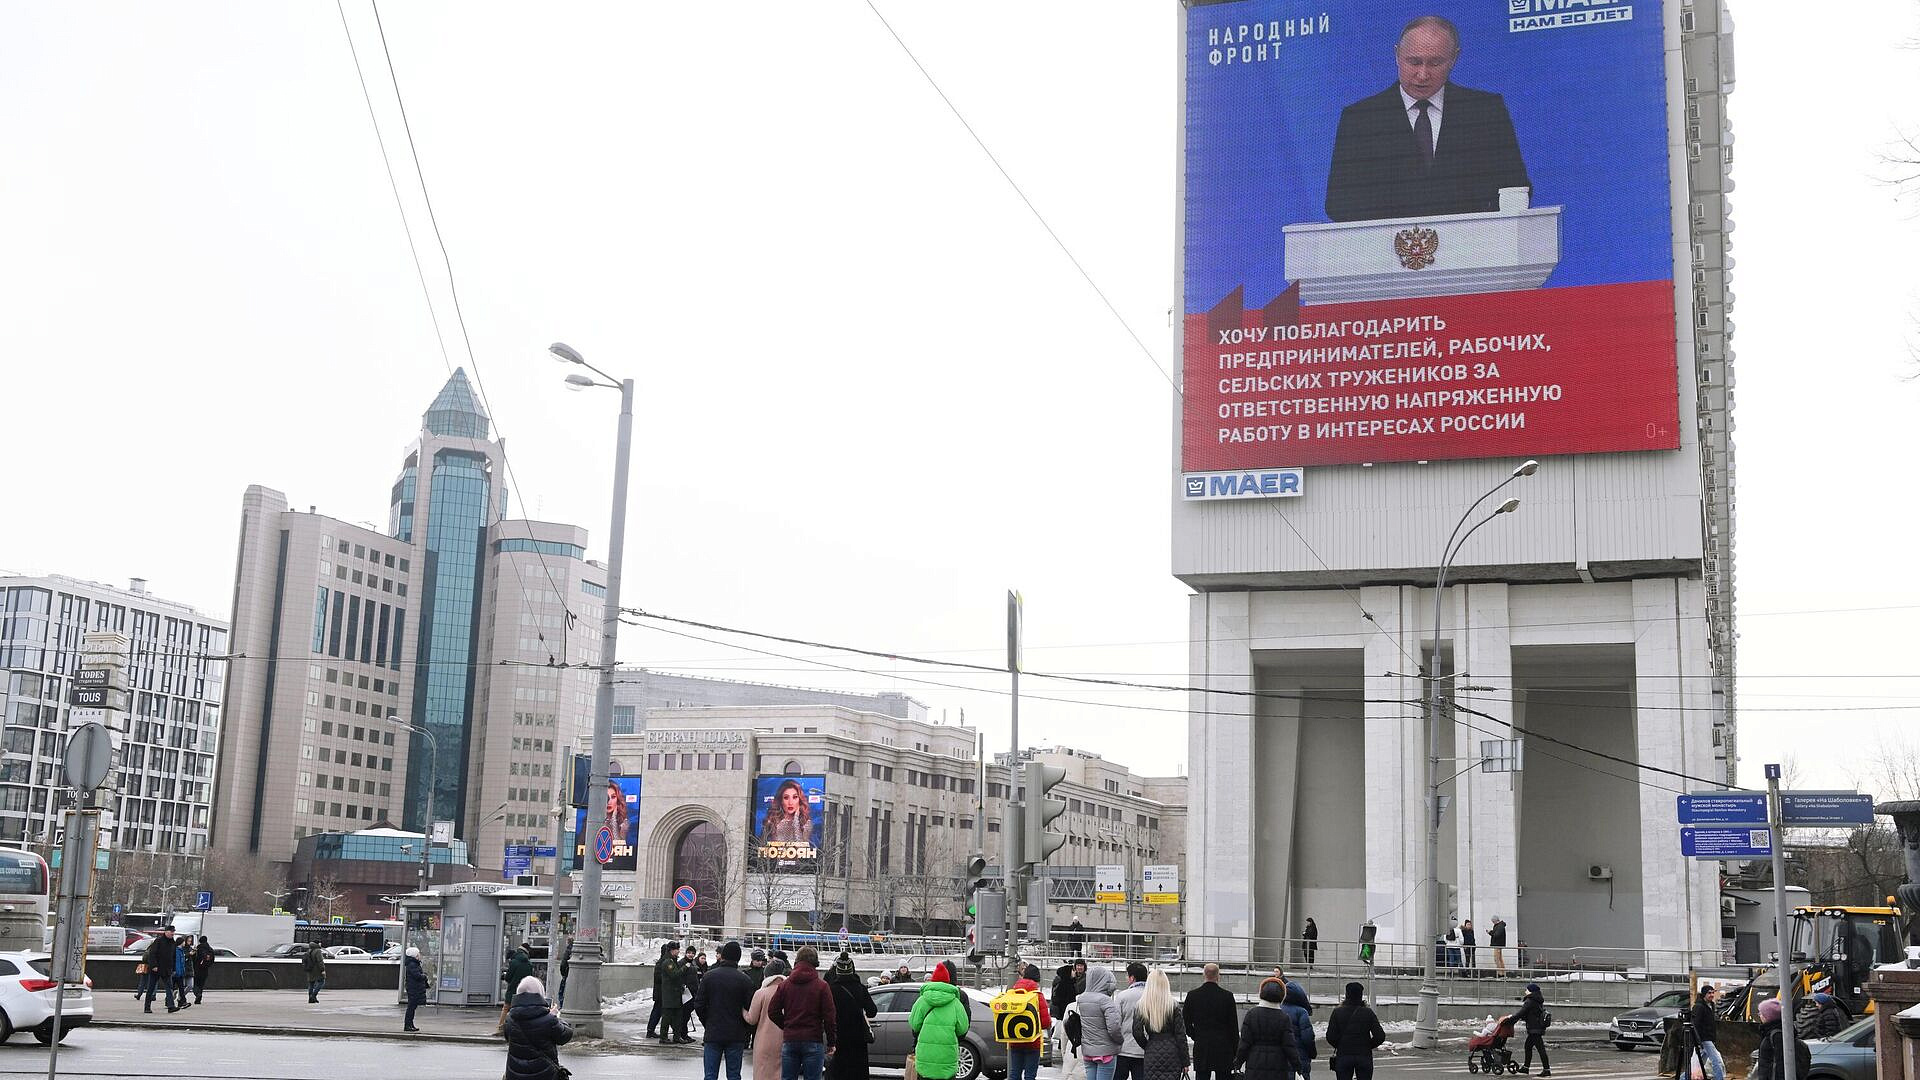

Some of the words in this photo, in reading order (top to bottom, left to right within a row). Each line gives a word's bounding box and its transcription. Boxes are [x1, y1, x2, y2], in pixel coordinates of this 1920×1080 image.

[1208, 12, 1329, 46] НАРОДНЫЙ
[1513, 16, 1556, 30] НАМ
[1561, 13, 1587, 25] 20
[1591, 8, 1629, 22] ЛЕТ
[1208, 41, 1282, 66] ФРОНТ
[1218, 326, 1268, 345] ХОЧУ
[1273, 315, 1447, 342] ПОБЛАГОДАРИТЬ
[1218, 336, 1443, 370] ПРЕДПРИНИМАТЕЛЕЙ,
[1449, 333, 1551, 356] РАБОЧИХ,
[1218, 372, 1323, 394] СЕЛЬСКИХ
[1327, 364, 1468, 389] ТРУЖЕНИКОВ
[1473, 362, 1501, 380] ЗА
[1218, 393, 1390, 419] ОТВЕТСТВЕННУЮ
[1395, 384, 1563, 410] НАПРЯЖЕННУЮ
[1218, 424, 1293, 445] РАБОТУ
[1298, 423, 1311, 440] В
[1316, 417, 1436, 439] ИНТЕРЕСАХ
[1440, 412, 1526, 433] РОССИИ
[1646, 422, 1668, 439] 0+
[1210, 472, 1299, 497] MAER
[79, 670, 105, 679] TODES
[78, 692, 101, 703] TOUS
[647, 730, 698, 743] ЕРЕВАН
[702, 730, 746, 743] ПЛАЗА
